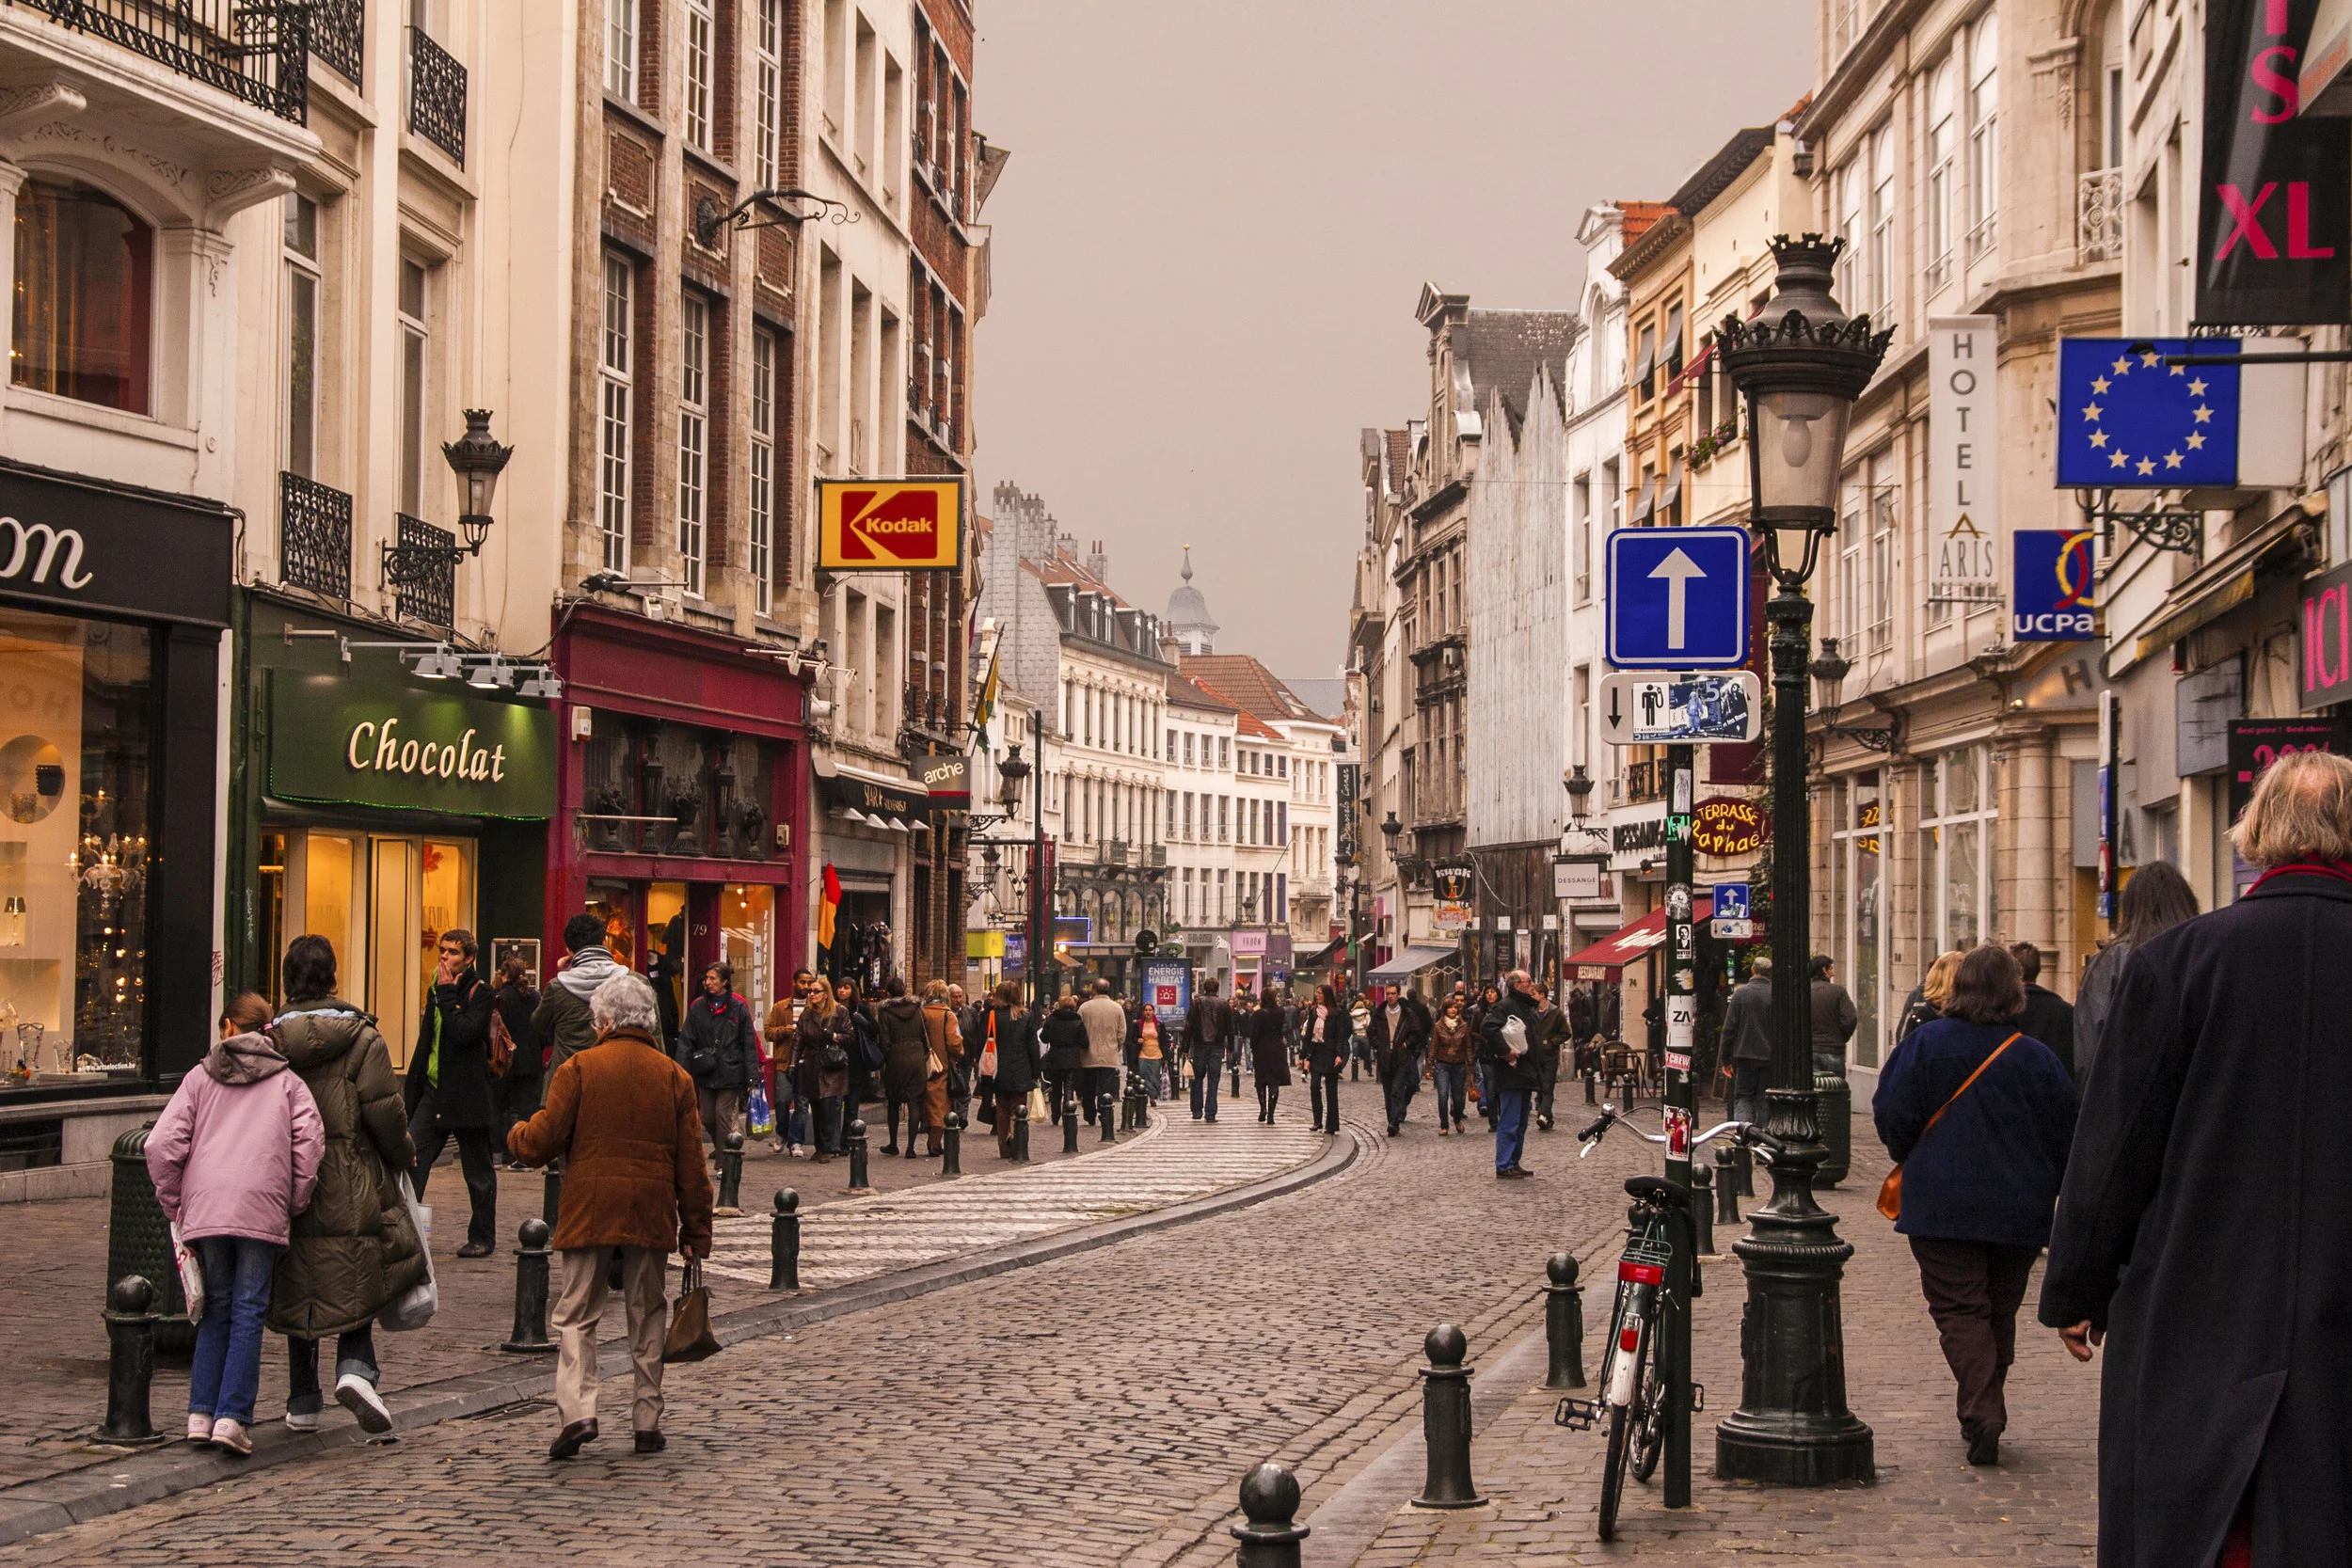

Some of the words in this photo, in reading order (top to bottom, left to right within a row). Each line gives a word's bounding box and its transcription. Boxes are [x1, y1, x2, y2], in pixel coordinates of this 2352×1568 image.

[2214, 181, 2335, 261] XL
[1949, 333, 1977, 506] HOTEL
[866, 517, 932, 533] Kodak
[1939, 541, 1994, 578] ARIS
[2305, 582, 2348, 692] ICI
[348, 718, 505, 783] Chocolat
[924, 762, 964, 784] arche
[1341, 768, 1350, 796] Corner
[864, 784, 878, 809] STAR
[1339, 800, 1351, 842] Brussels
[1696, 803, 1759, 826] TERRASSE
[1716, 818, 1735, 831] du
[692, 923, 707, 936] 79
[1149, 967, 1184, 975] ÉNERGIE
[1629, 978, 1638, 987] 74
[1161, 1006, 1171, 1015] 24
[1176, 1006, 1184, 1015] 25
[1669, 1053, 1691, 1067] CREW
